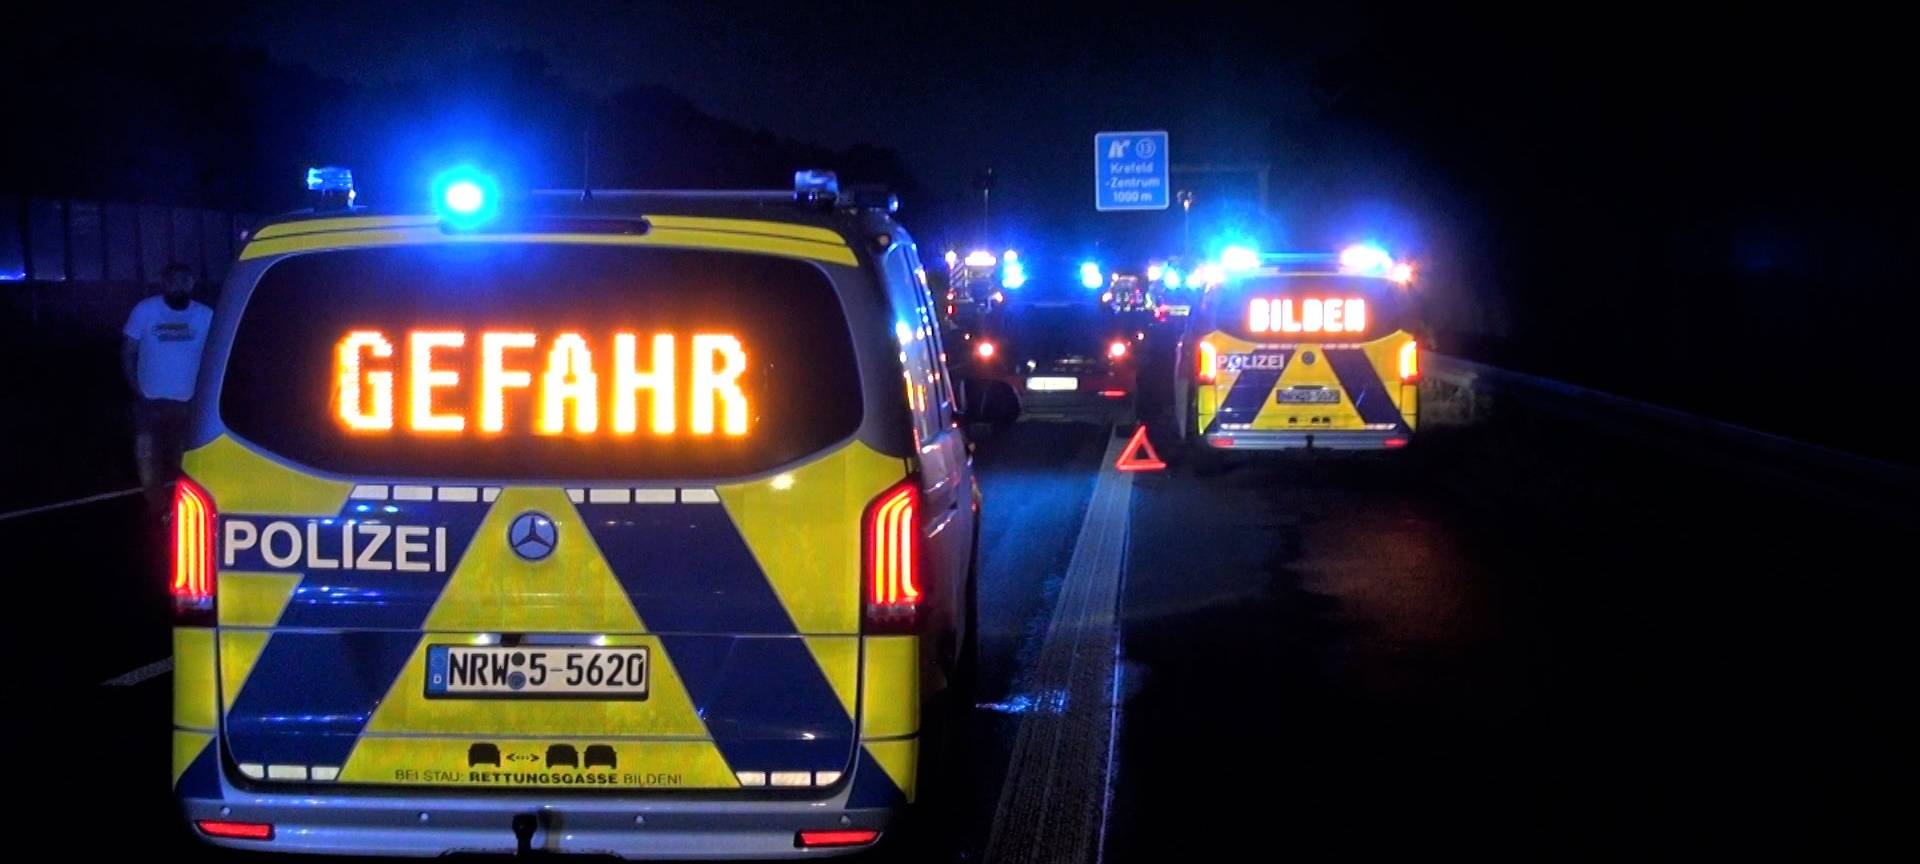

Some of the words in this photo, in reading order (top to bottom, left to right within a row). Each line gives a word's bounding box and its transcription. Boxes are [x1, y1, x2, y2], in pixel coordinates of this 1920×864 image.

[1111, 162, 1154, 174] Krefeld
[1113, 191, 1139, 203] 1000
[1141, 193, 1152, 203] m
[1249, 298, 1365, 332] BILDEN
[1216, 353, 1284, 369] POLIZEI
[336, 330, 748, 436] GEFAHR
[224, 520, 446, 572] POLIZEI
[449, 653, 510, 686] NRW
[528, 653, 644, 687] 5-5620
[394, 769, 419, 780] BEI
[469, 771, 618, 784] RETTUNGSGASSE
